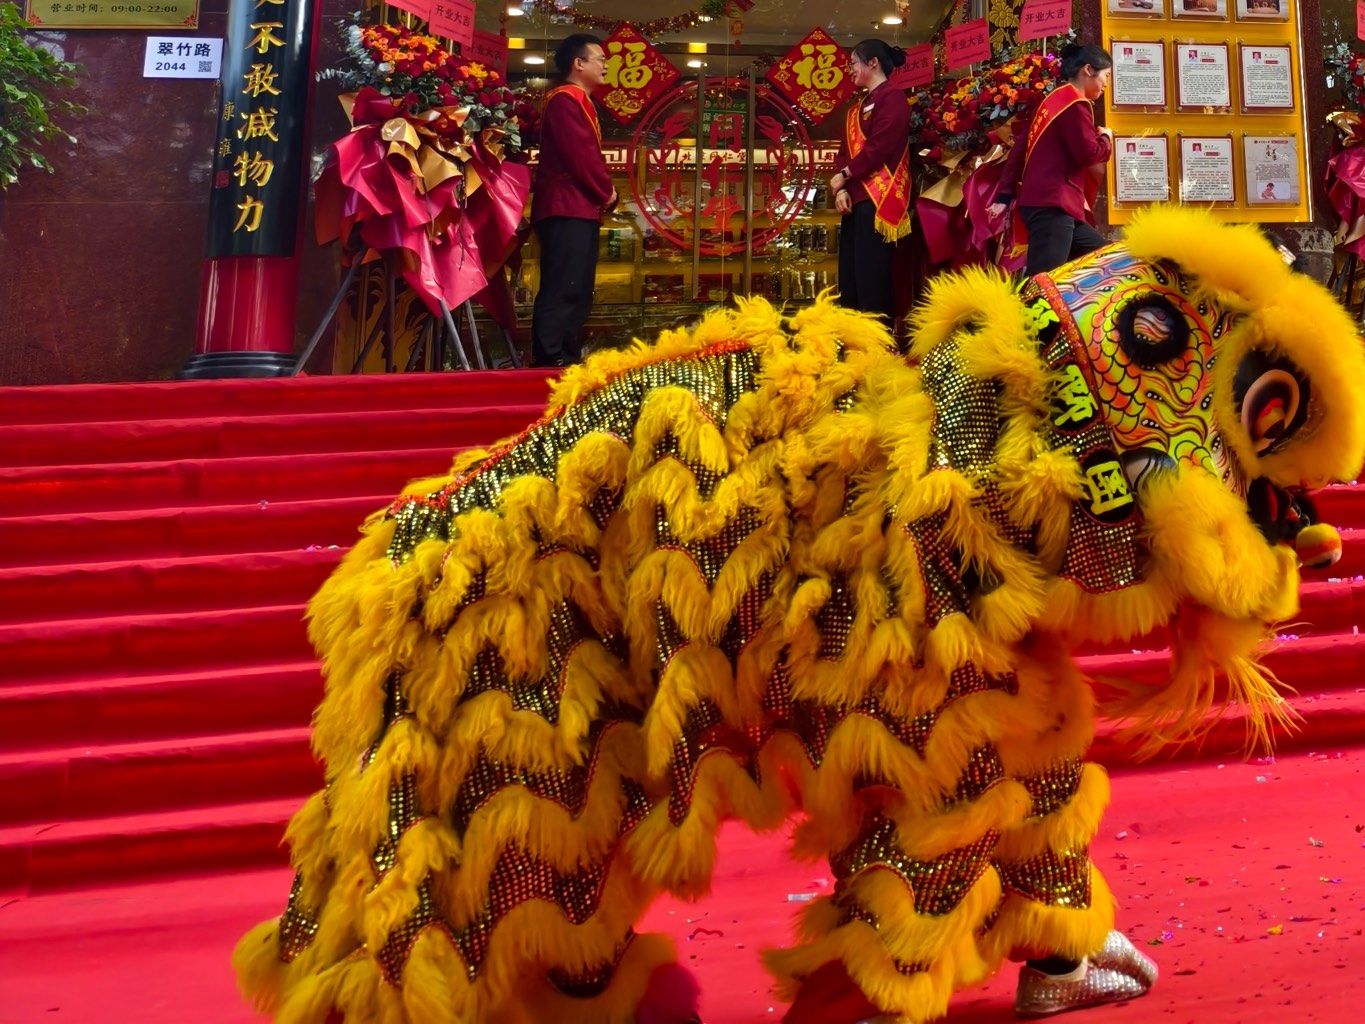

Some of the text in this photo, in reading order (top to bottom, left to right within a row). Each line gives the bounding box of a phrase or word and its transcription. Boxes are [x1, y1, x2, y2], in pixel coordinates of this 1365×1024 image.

[111, 4, 178, 14] 09:00-22:00
[435, 4, 471, 27] 开业大吉
[1025, 8, 1067, 24] 开业大吉
[157, 41, 212, 58] 翠竹路
[950, 33, 985, 53] 开业大吉
[155, 62, 187, 72] 2044
[602, 40, 653, 90] 福
[794, 42, 844, 90] 福
